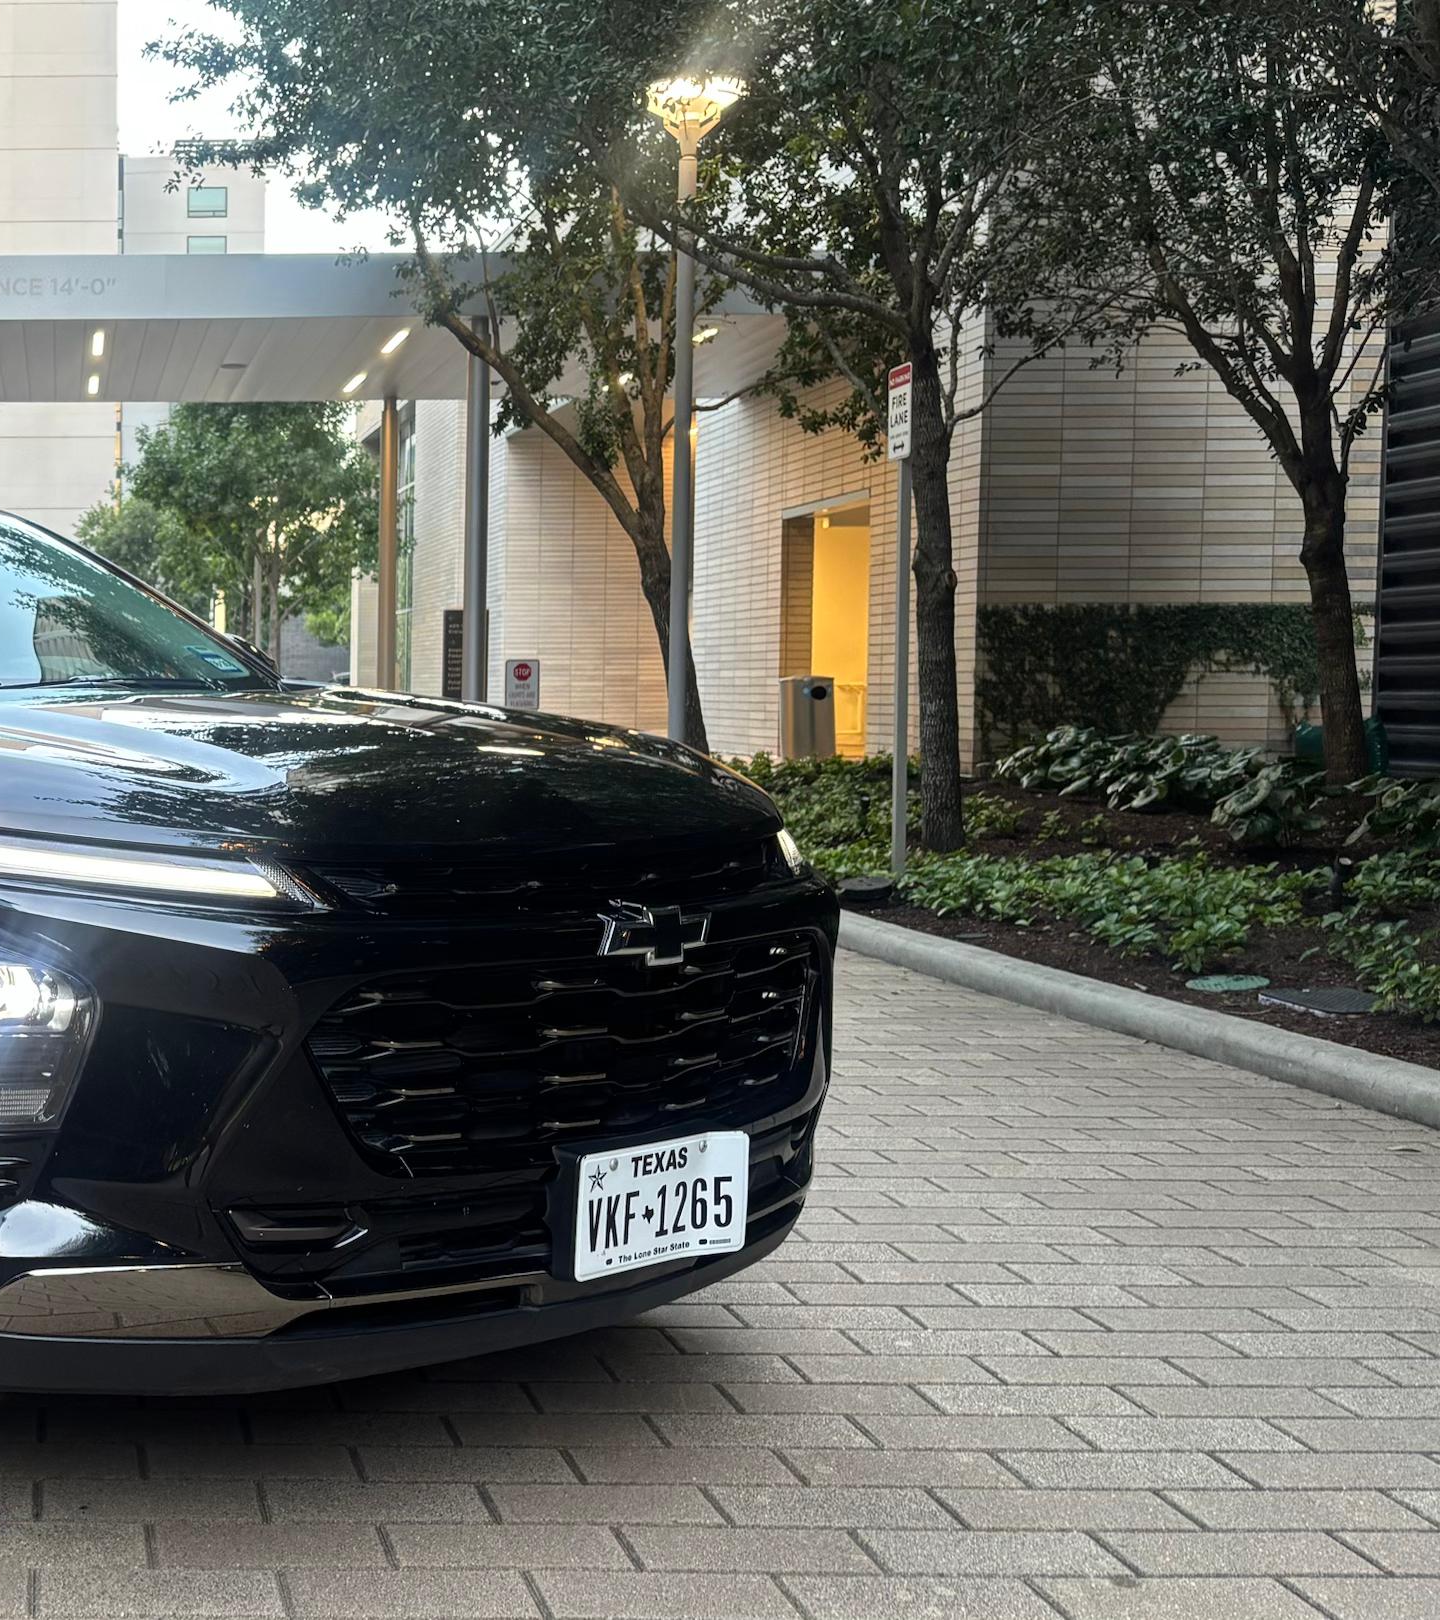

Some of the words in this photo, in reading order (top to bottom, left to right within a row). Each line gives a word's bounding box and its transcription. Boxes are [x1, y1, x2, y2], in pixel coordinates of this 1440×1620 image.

[892, 392, 907, 410] FIRE
[890, 410, 908, 428] LANE
[514, 667, 531, 677] STOP
[631, 1147, 688, 1178] TEXAS
[588, 1190, 640, 1253] VKF
[654, 1175, 733, 1238] 1265
[618, 1254, 633, 1264] The
[634, 1250, 652, 1260] Lone
[653, 1246, 668, 1256] Star
[670, 1241, 690, 1251] State
